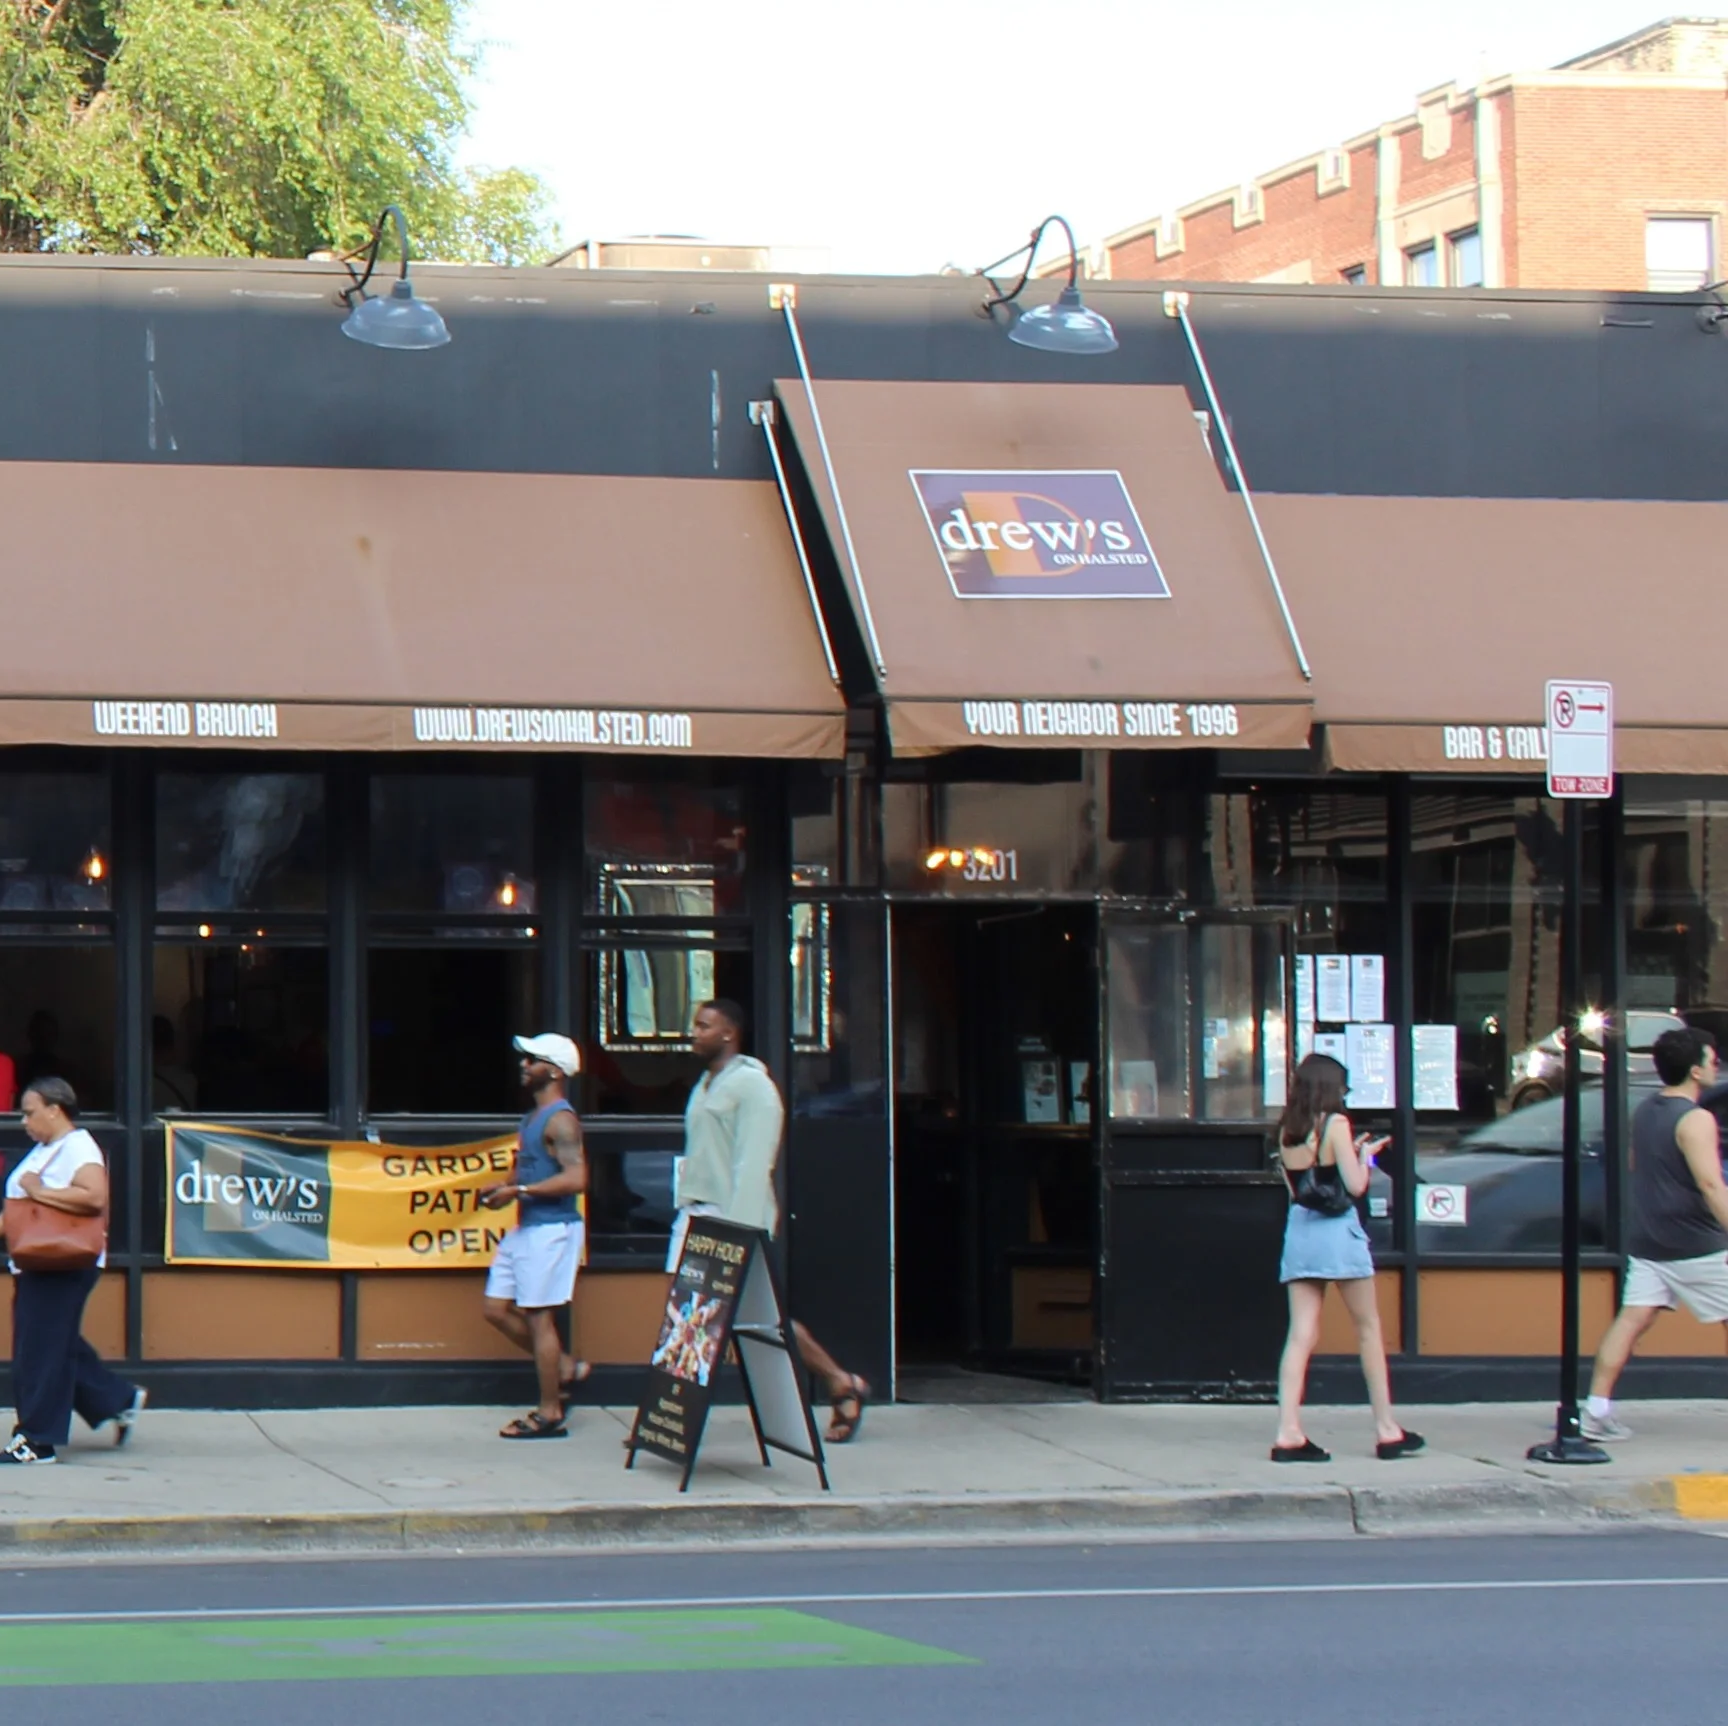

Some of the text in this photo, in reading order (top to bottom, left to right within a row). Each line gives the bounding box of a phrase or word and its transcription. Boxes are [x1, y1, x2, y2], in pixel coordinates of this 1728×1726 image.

[940, 508, 1132, 551] drew's
[1053, 554, 1148, 565] ON HALSTED
[93, 701, 279, 738] WEEKEND BRUNCH
[412, 708, 692, 748] WWW.DREWSONHALSTED.COM
[962, 701, 1239, 737] YOUR NEIGHBOR SINCE 1996
[1443, 726, 1485, 759] BAR
[1486, 725, 1503, 759] &
[1555, 777, 1607, 792] TOW ZONE
[963, 849, 1018, 881] 3201
[175, 1159, 319, 1210] drew's
[409, 1187, 481, 1214] PATI
[252, 1209, 323, 1223] ON HALSTED
[685, 1232, 745, 1266] HAPPY HOUR
